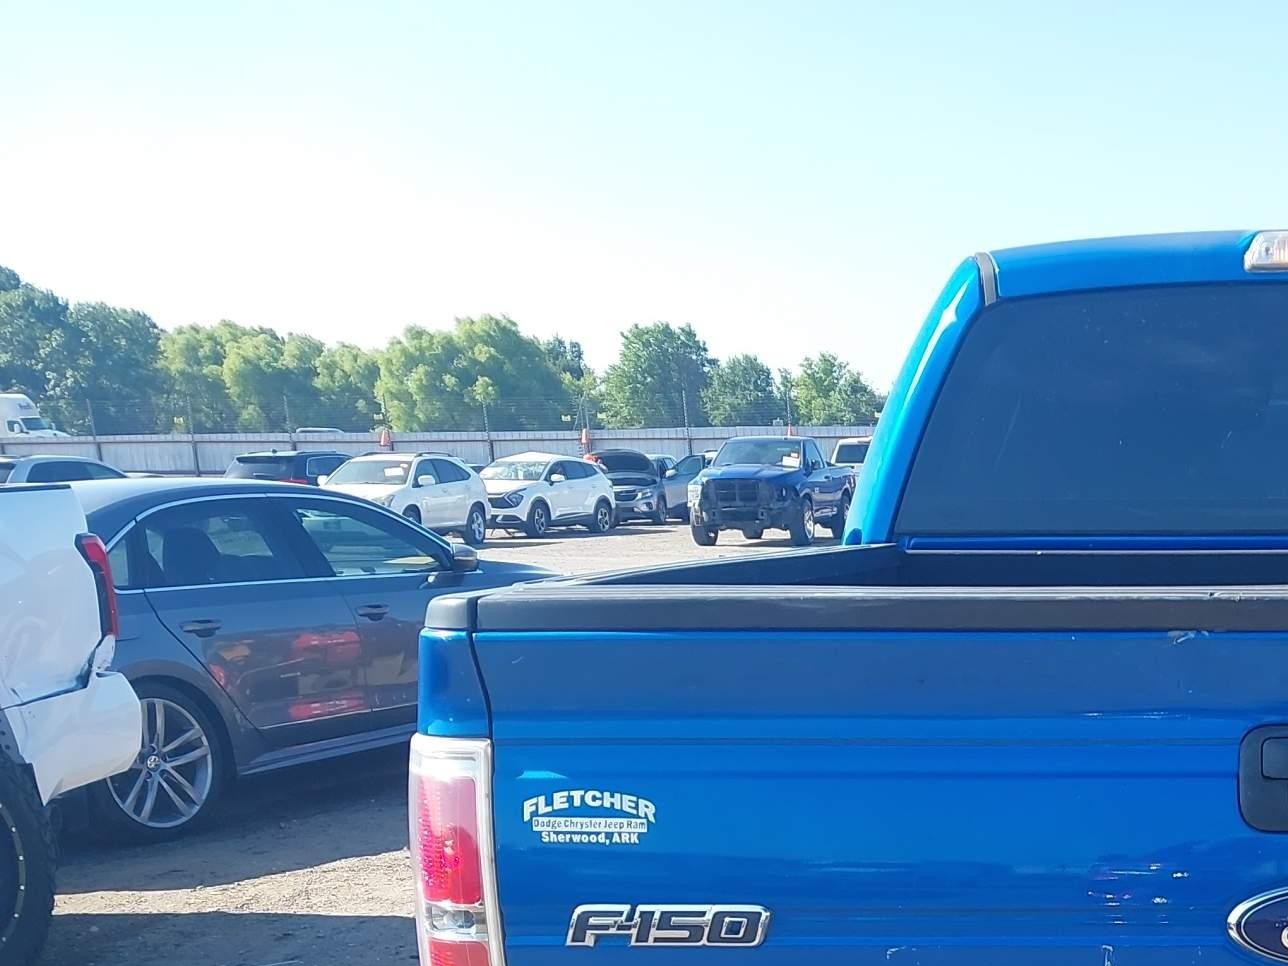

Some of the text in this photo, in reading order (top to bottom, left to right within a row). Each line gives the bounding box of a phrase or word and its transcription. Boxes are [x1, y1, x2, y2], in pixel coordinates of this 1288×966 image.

[523, 790, 656, 823] FLETCHER
[533, 819, 646, 830] Dodge Chrysler Jeep Ram
[541, 832, 639, 845] Sherwood, ARK
[565, 904, 771, 947] F-150
